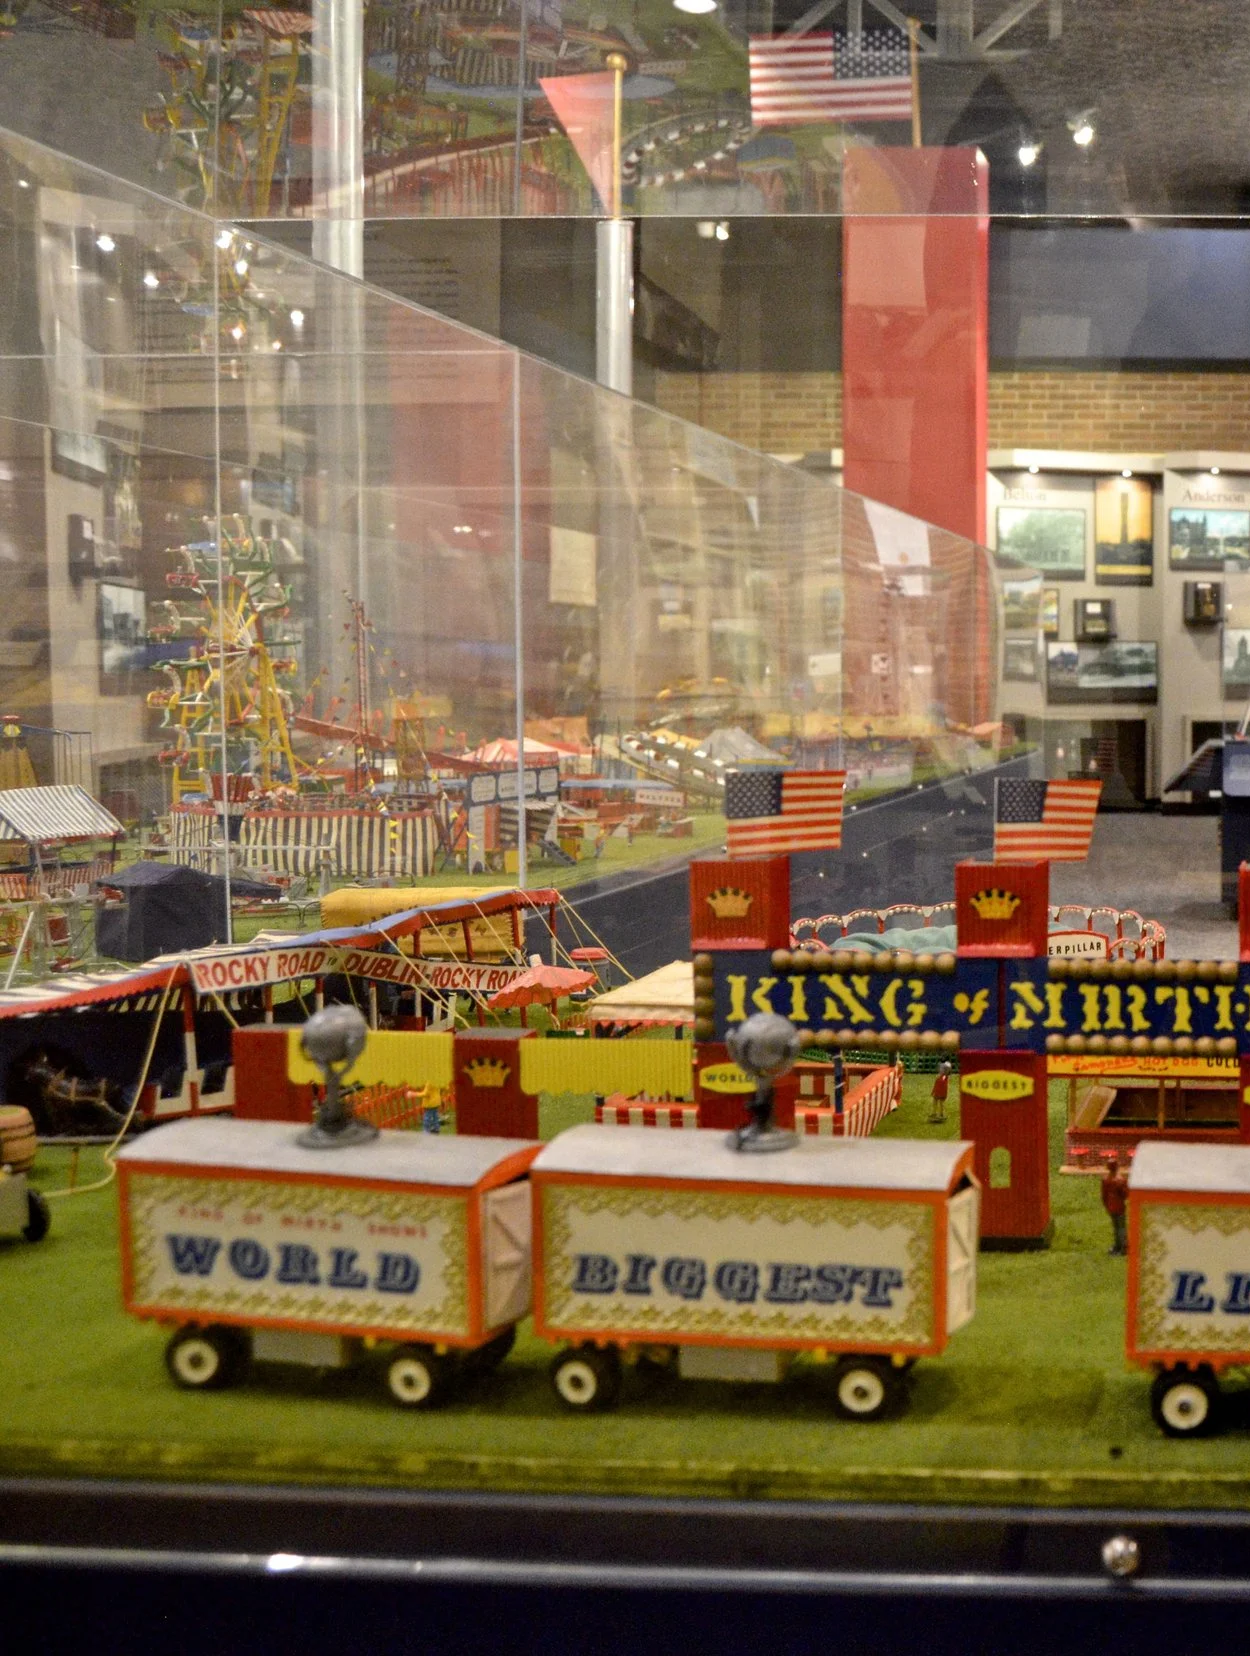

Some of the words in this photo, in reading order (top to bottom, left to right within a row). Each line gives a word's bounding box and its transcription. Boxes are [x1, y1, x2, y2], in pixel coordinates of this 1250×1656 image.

[1182, 488, 1246, 503] Anderson
[1048, 941, 1102, 956] ERPILLAR
[194, 956, 271, 990] ROCKY
[277, 950, 326, 978] ROAD
[340, 953, 429, 986] DUBLIN
[429, 966, 487, 988] ROCKY
[487, 969, 527, 989] ROA
[726, 972, 928, 1027] KING
[966, 1079, 1028, 1092] BIGGEST
[165, 1232, 421, 1294] WORLD
[572, 1253, 903, 1307] BIGGEST
